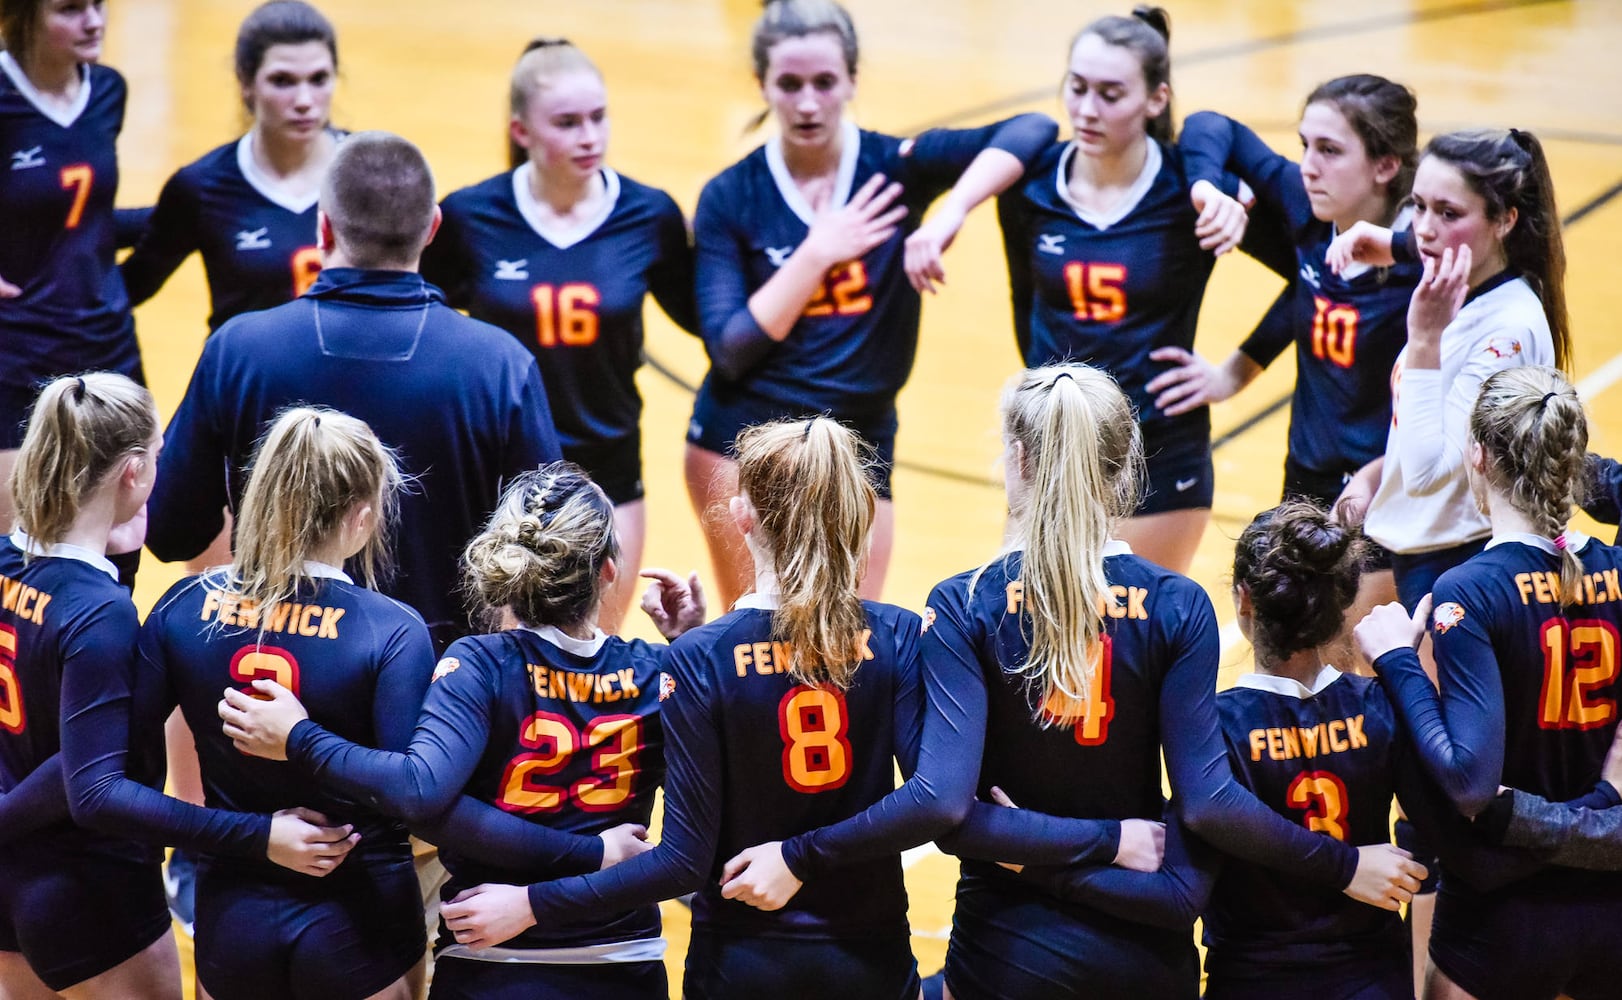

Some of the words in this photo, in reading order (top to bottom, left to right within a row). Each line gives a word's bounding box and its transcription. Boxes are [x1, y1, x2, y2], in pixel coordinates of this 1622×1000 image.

[59, 163, 95, 230] 7
[531, 282, 600, 348] 16
[1063, 261, 1128, 323] 15
[1311, 297, 1360, 368] 10
[0, 574, 52, 626] WICK
[1006, 581, 1149, 620] FICK
[733, 629, 875, 677] FENK
[1538, 617, 1622, 731] 12
[1038, 632, 1115, 746] 4
[496, 711, 645, 813] 23
[778, 682, 853, 793] 8
[1248, 713, 1369, 762] FENWICK
[1286, 770, 1350, 842] 3
